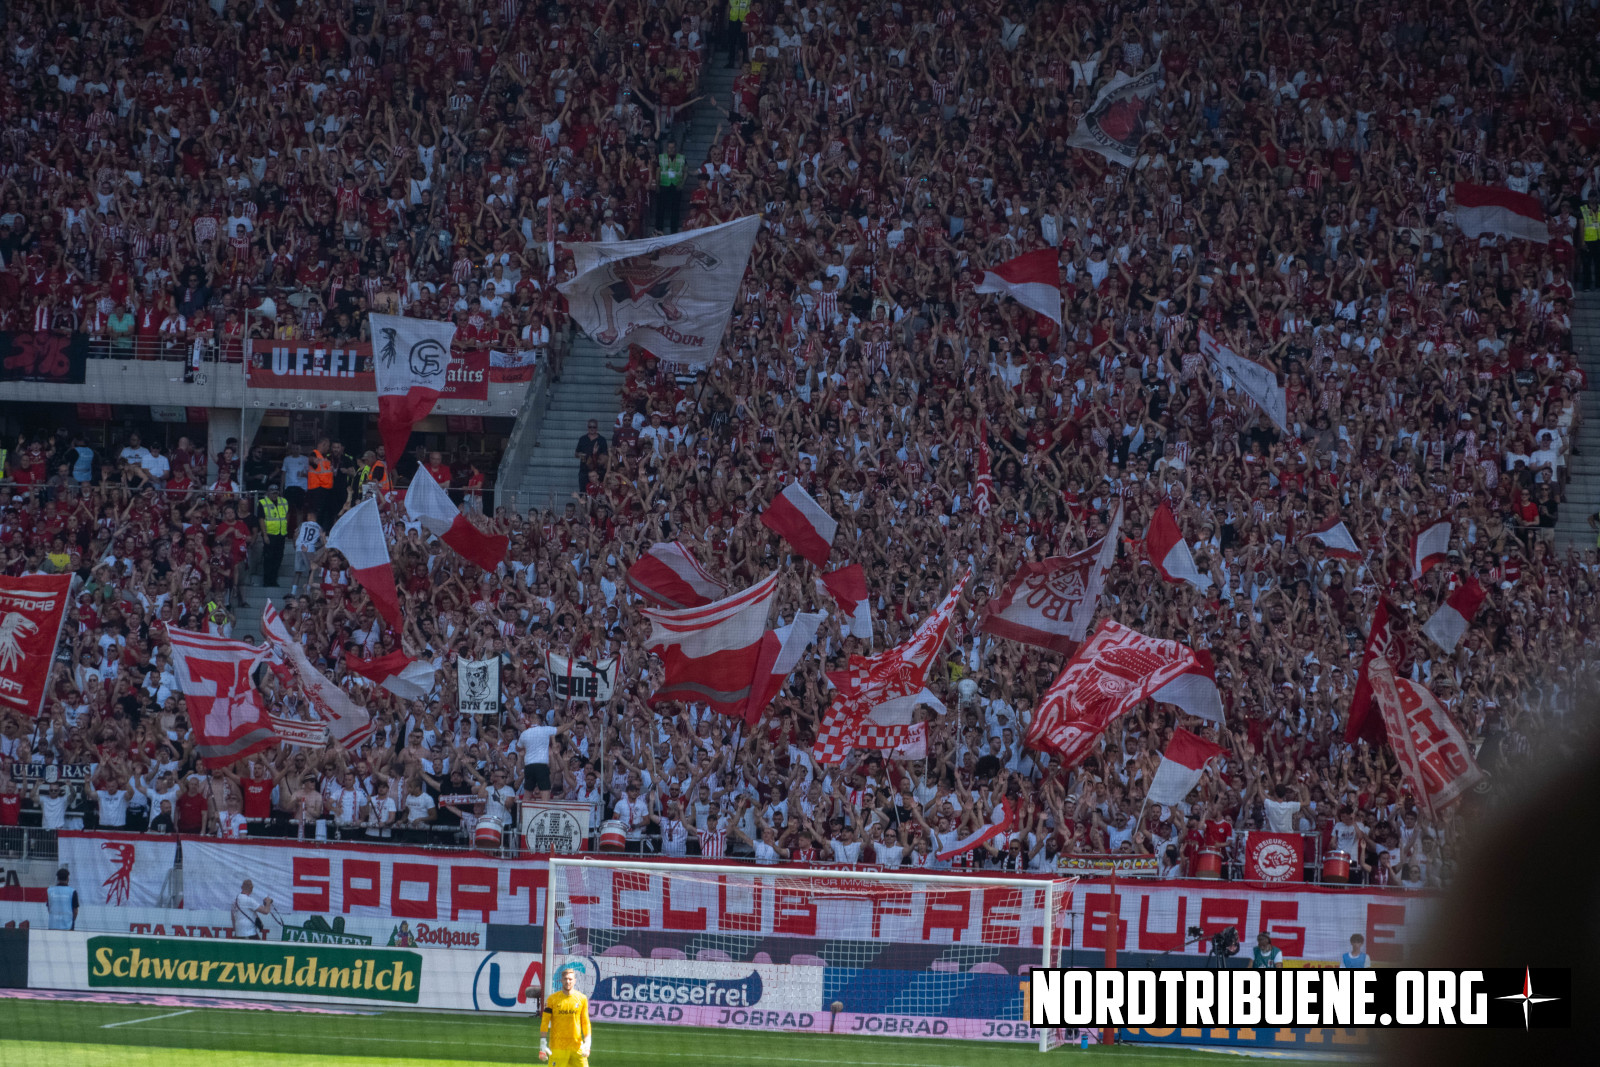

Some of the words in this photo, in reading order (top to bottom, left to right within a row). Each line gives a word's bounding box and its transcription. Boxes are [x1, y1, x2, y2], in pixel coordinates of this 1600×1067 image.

[303, 527, 316, 541] 18
[461, 701, 481, 710] SYN
[416, 922, 480, 947] Rothaus
[93, 947, 416, 992] Schwarzwaldmilch
[611, 977, 750, 1007] lactosefrei
[588, 1002, 684, 1022] JOBRAD
[717, 1009, 815, 1028] JOBRAD
[851, 1016, 949, 1035] JOBRAD
